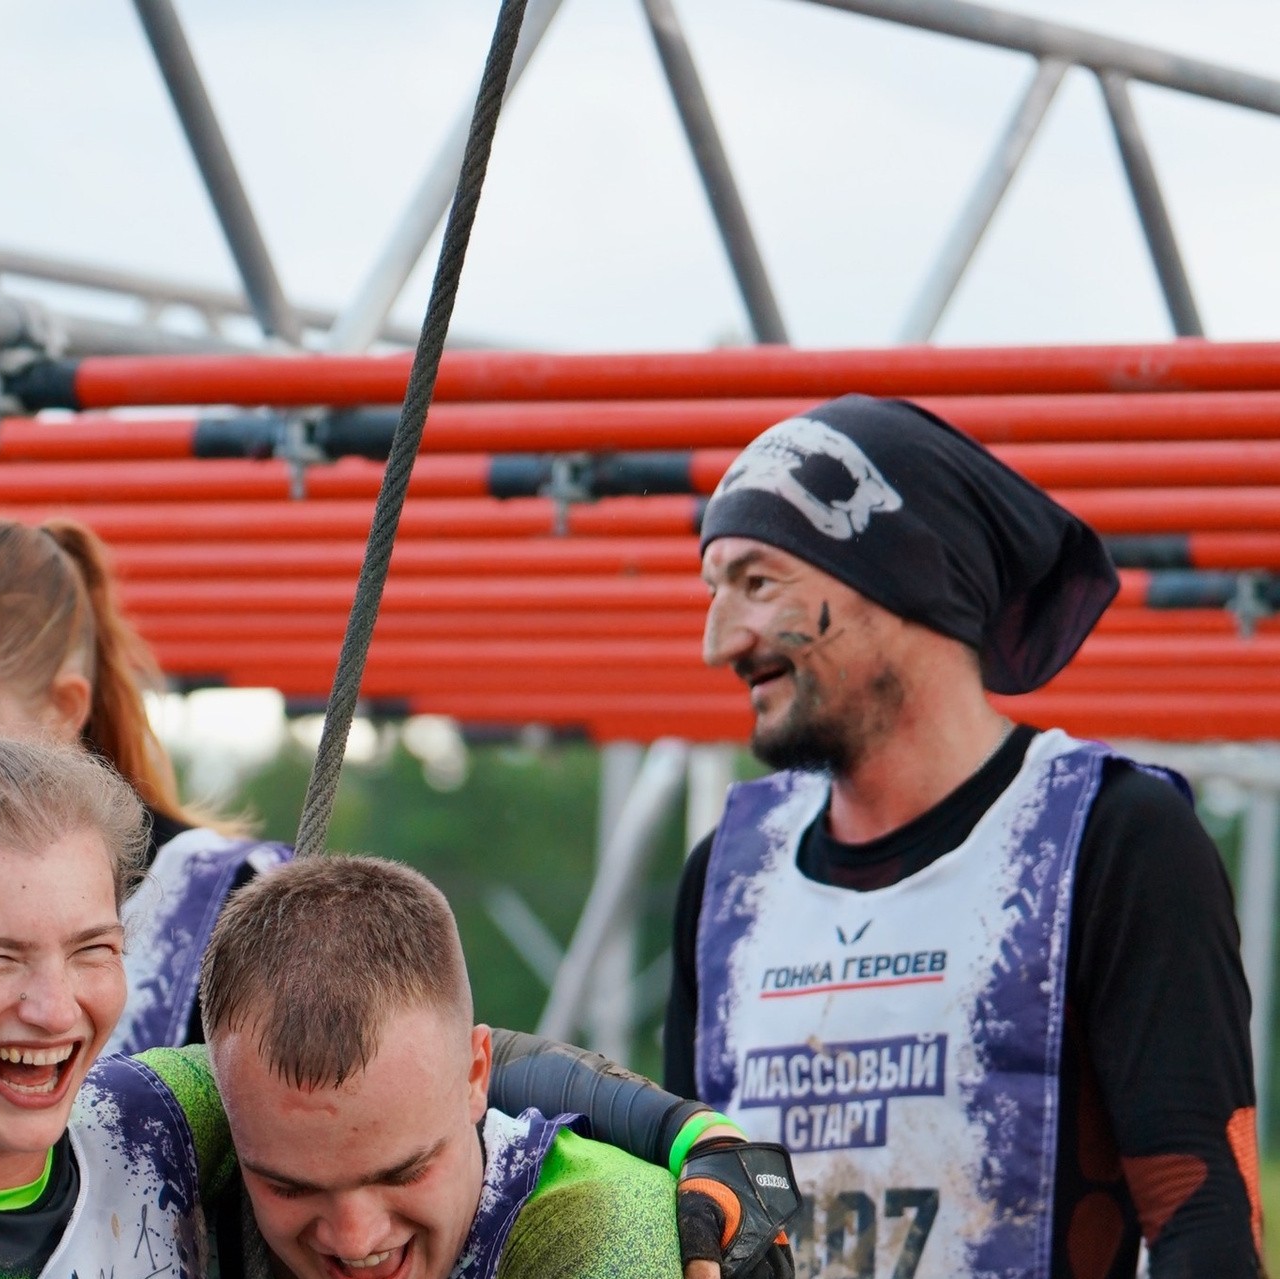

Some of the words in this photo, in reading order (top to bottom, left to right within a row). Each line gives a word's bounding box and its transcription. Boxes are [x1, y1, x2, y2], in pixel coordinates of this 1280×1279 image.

[762, 960, 833, 990] ГОНКА
[843, 949, 948, 980] ГЕРОЕВ
[744, 1034, 939, 1100] МАССОВЫЙ
[785, 1100, 882, 1149] СТАРТ
